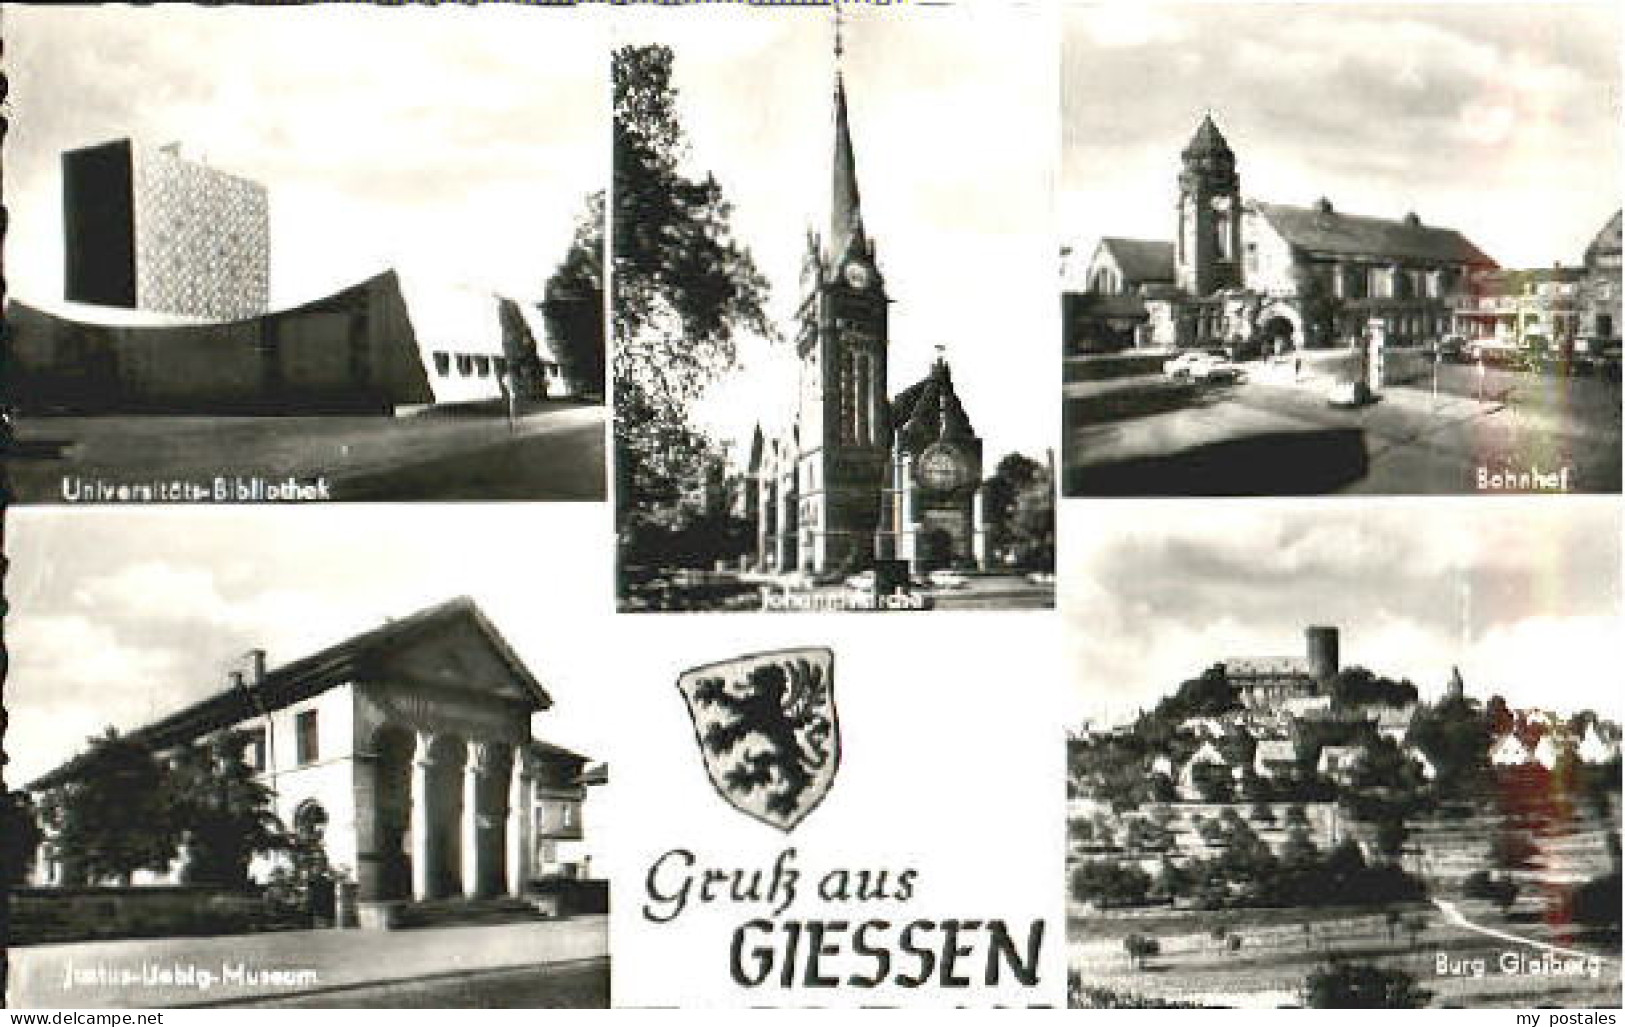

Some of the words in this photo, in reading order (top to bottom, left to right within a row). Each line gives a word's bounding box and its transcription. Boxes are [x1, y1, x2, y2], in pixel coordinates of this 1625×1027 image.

[642, 847, 800, 924] Gruß
[817, 868, 919, 901] aus
[729, 919, 1045, 989] GIESSEN
[1435, 952, 1486, 978] Burg
